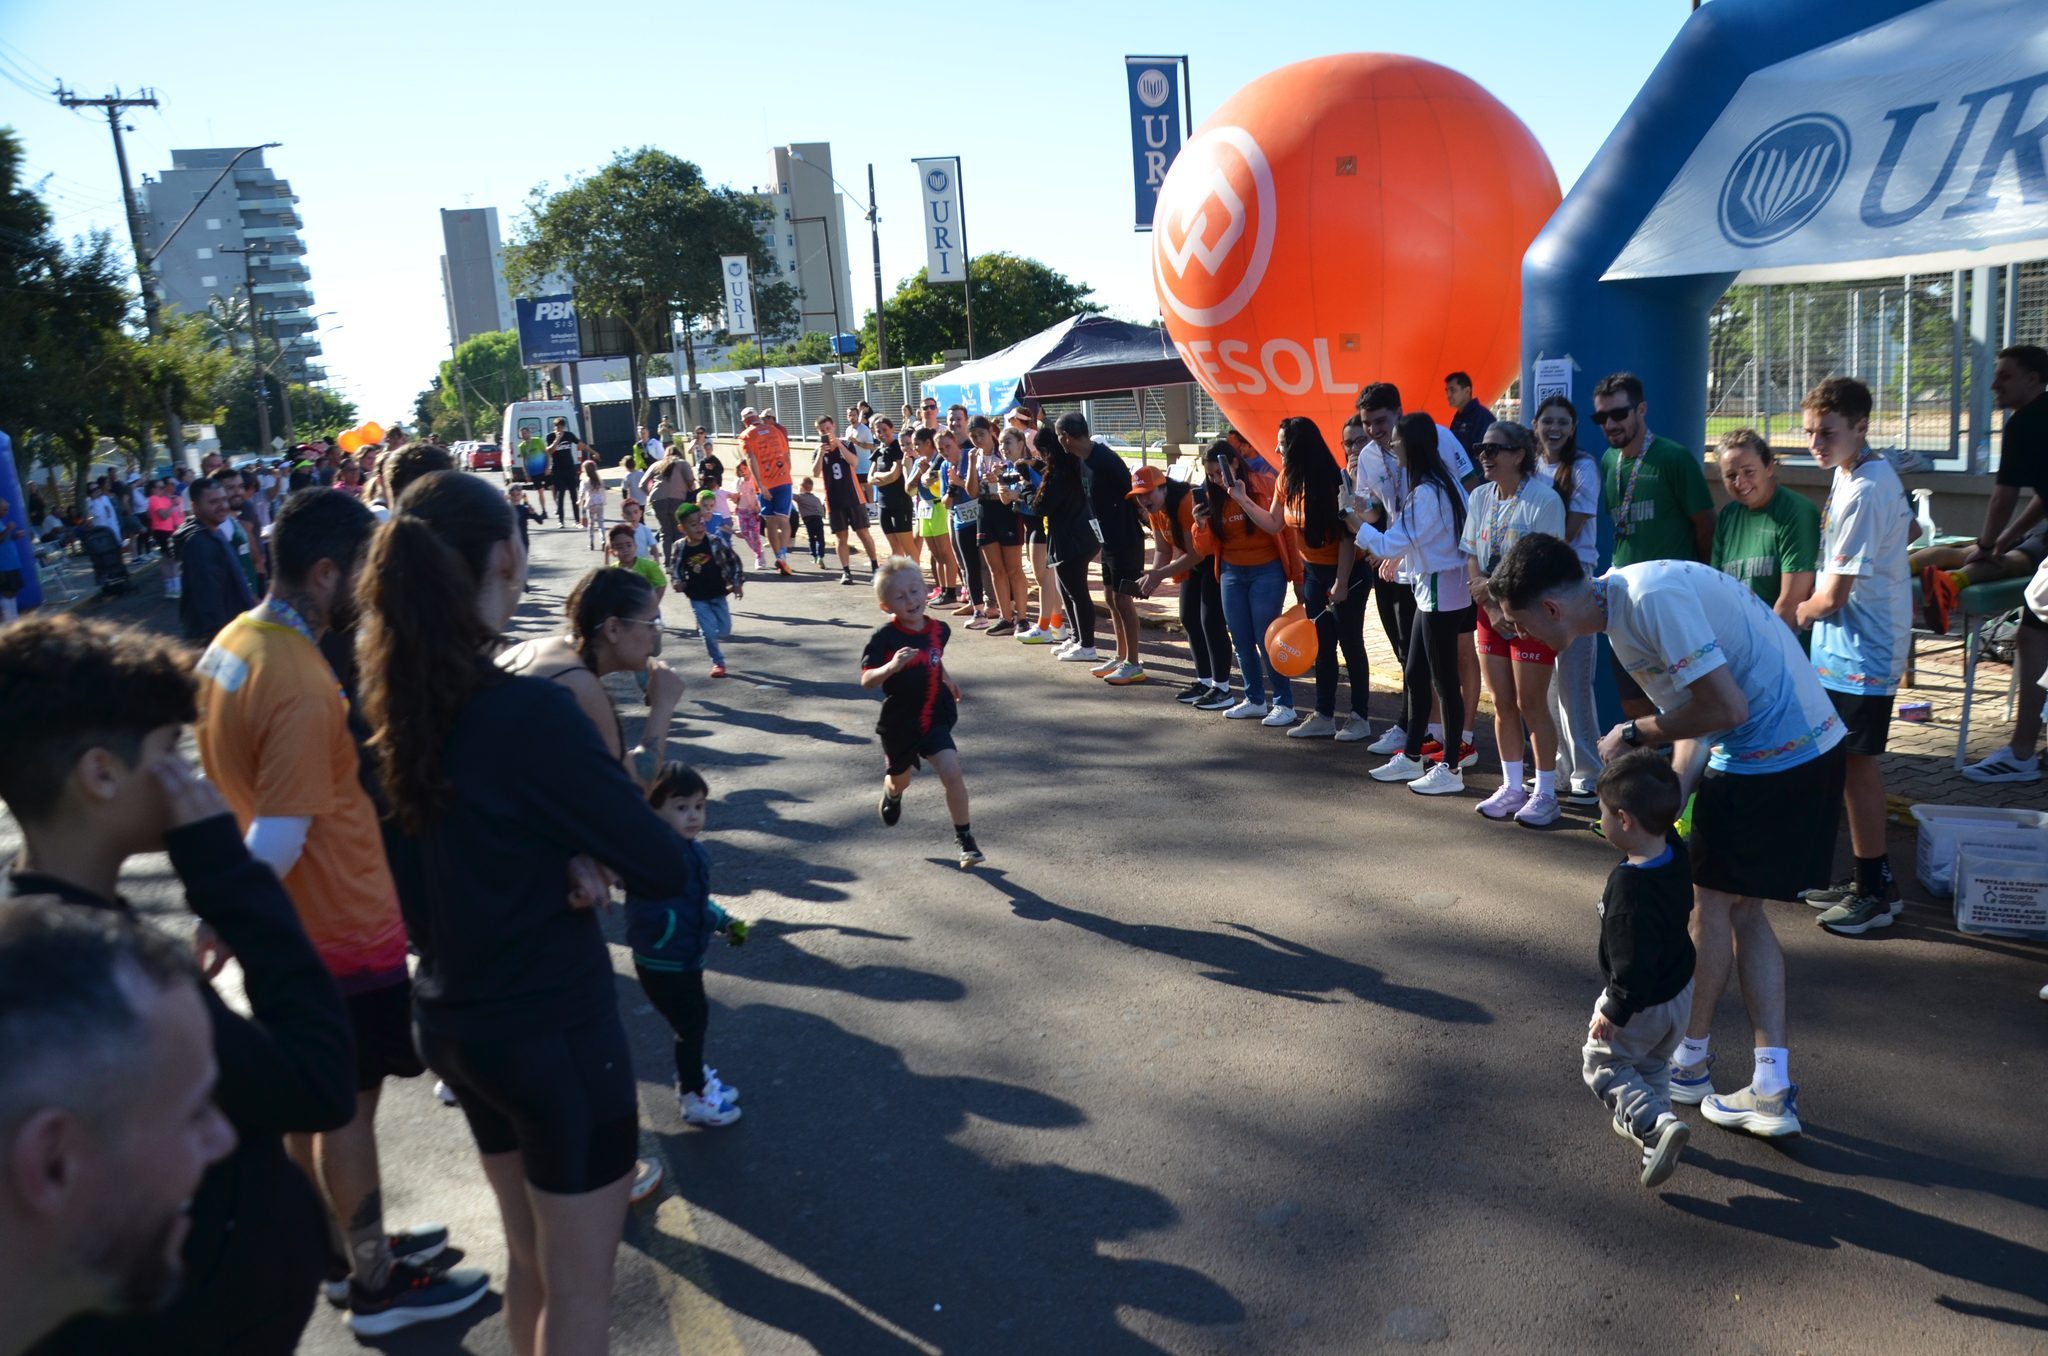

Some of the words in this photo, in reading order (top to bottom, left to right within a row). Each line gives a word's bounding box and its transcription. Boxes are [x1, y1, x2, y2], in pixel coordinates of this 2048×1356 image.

[930, 200, 953, 274] URI
[730, 281, 746, 329] URI
[831, 462, 843, 480] 9
